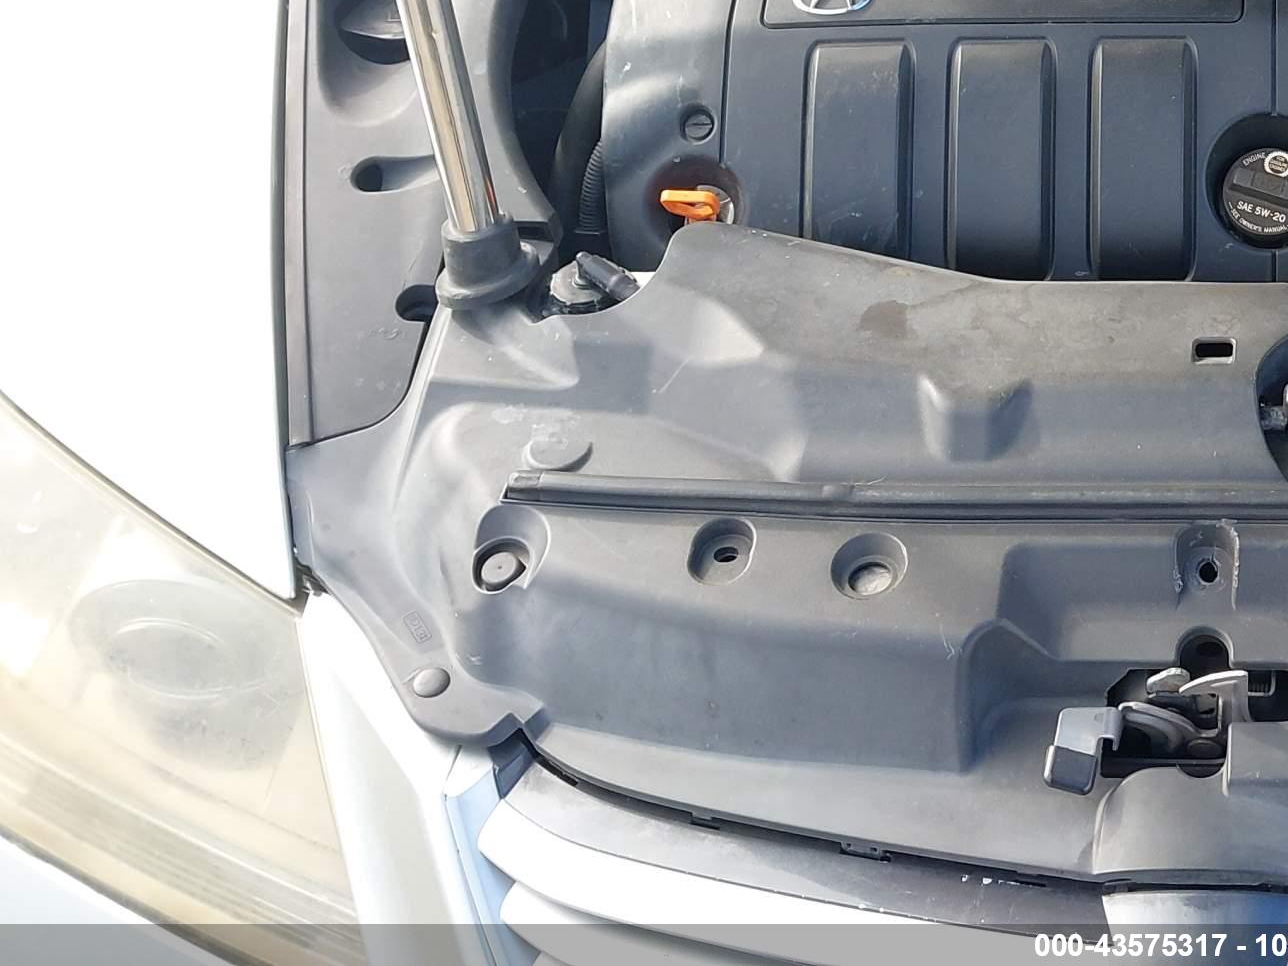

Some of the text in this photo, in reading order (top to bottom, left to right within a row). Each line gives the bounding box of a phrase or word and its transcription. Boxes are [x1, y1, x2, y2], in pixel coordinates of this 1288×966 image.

[1242, 152, 1266, 166] ENGINE
[1236, 200, 1287, 224] SAE 5W-20
[1263, 224, 1288, 233] MANUAL
